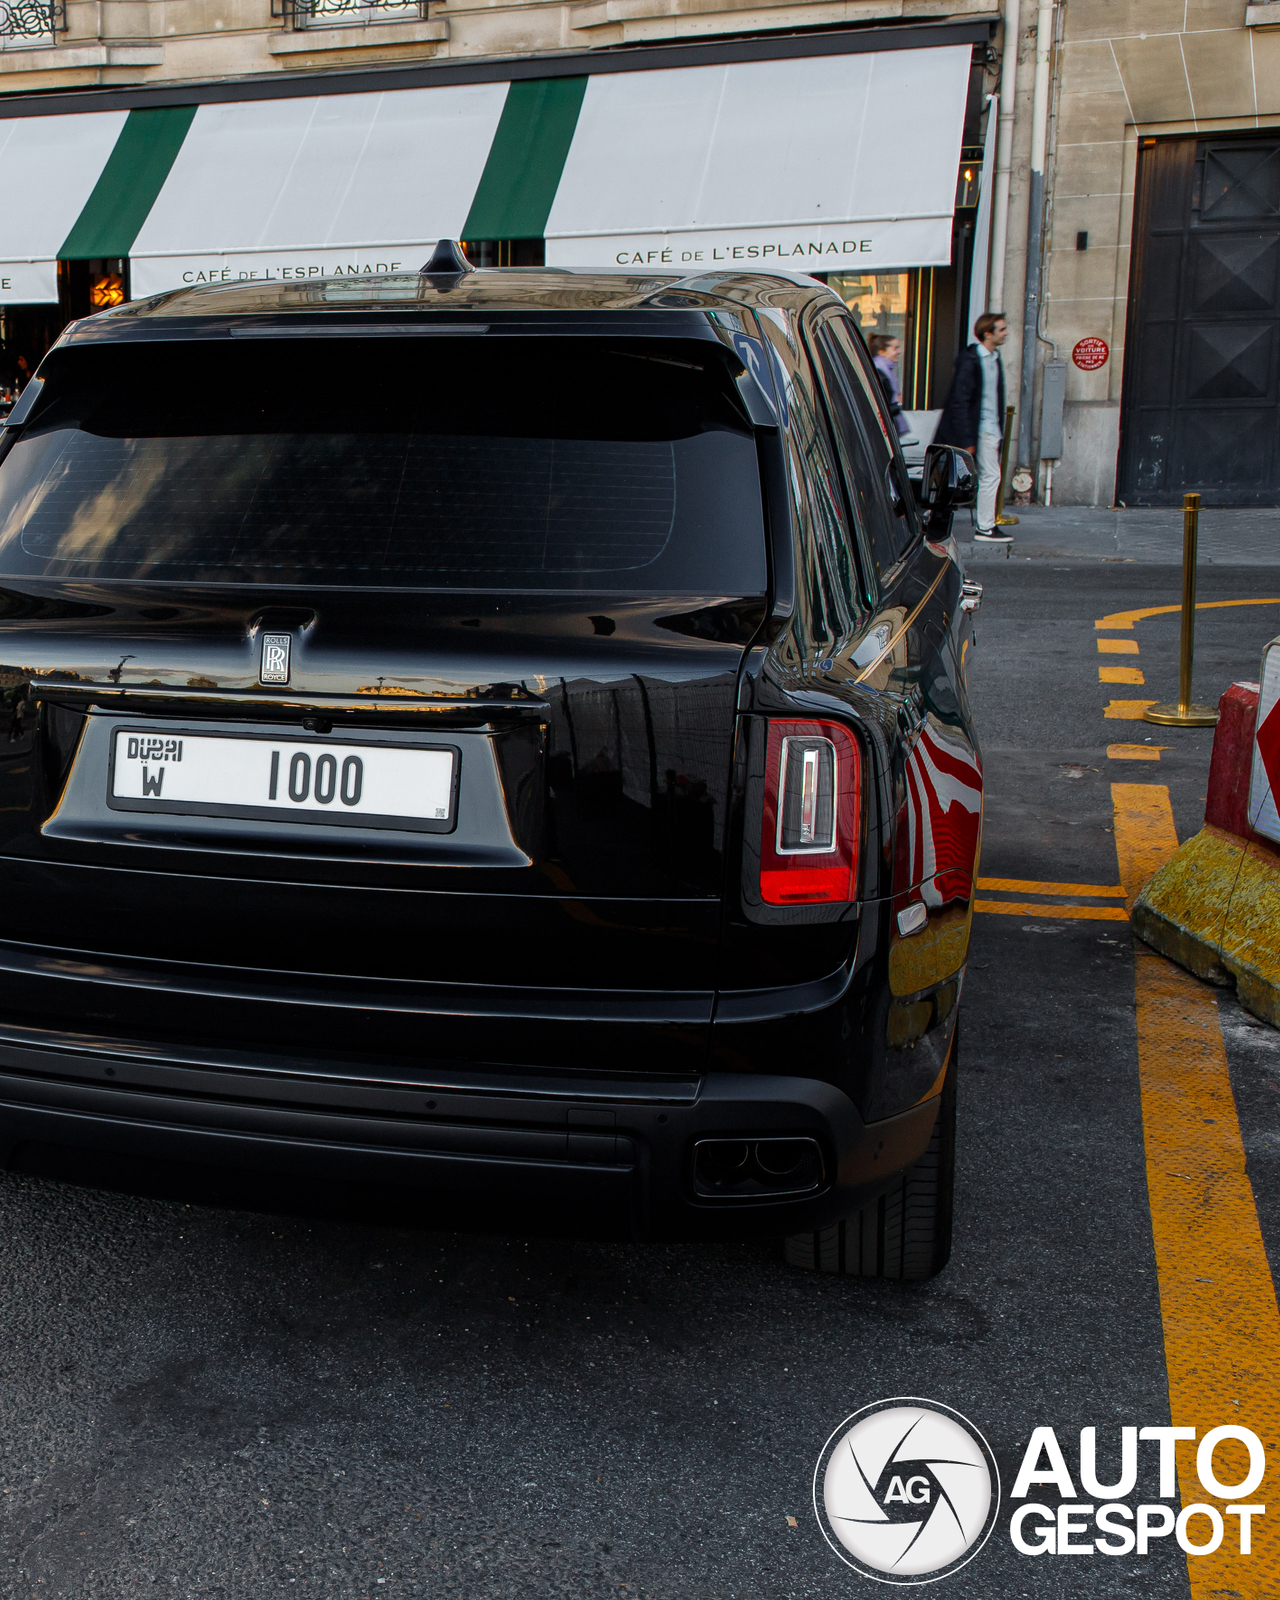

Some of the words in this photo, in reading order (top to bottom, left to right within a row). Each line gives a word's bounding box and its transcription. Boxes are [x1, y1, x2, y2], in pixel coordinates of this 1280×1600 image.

[615, 246, 674, 265] CAFÉ
[680, 250, 705, 262] DE
[712, 239, 873, 261] L'ESPLANADE
[182, 265, 231, 283] CAFÉ
[1075, 346, 1106, 354] VOITURE
[263, 673, 286, 681] ROYCE
[142, 766, 165, 797] W
[268, 751, 364, 806] 1000
